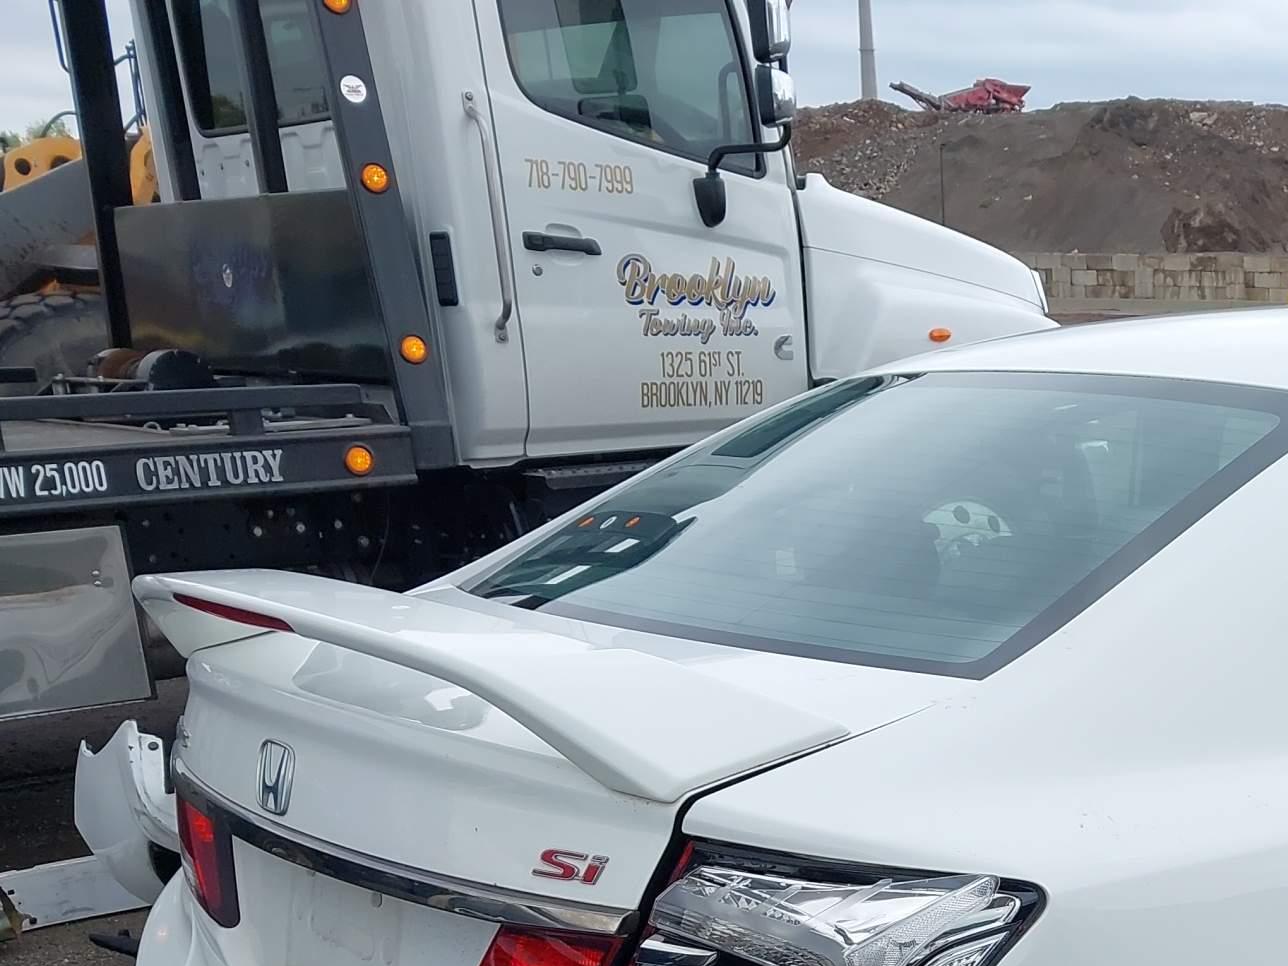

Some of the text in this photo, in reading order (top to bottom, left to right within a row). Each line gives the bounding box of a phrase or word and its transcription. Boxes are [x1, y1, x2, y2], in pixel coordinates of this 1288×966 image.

[524, 158, 634, 194] 718-790-7999
[616, 253, 776, 312] Brooklyn
[639, 308, 759, 344] Towing Inc.
[660, 351, 694, 378] 1325
[726, 350, 745, 377] ST.
[641, 379, 763, 408] BROOKLYN, NY 11219
[31, 460, 108, 497] 25,000
[136, 449, 284, 491] CENTURY
[532, 849, 610, 885] Si
